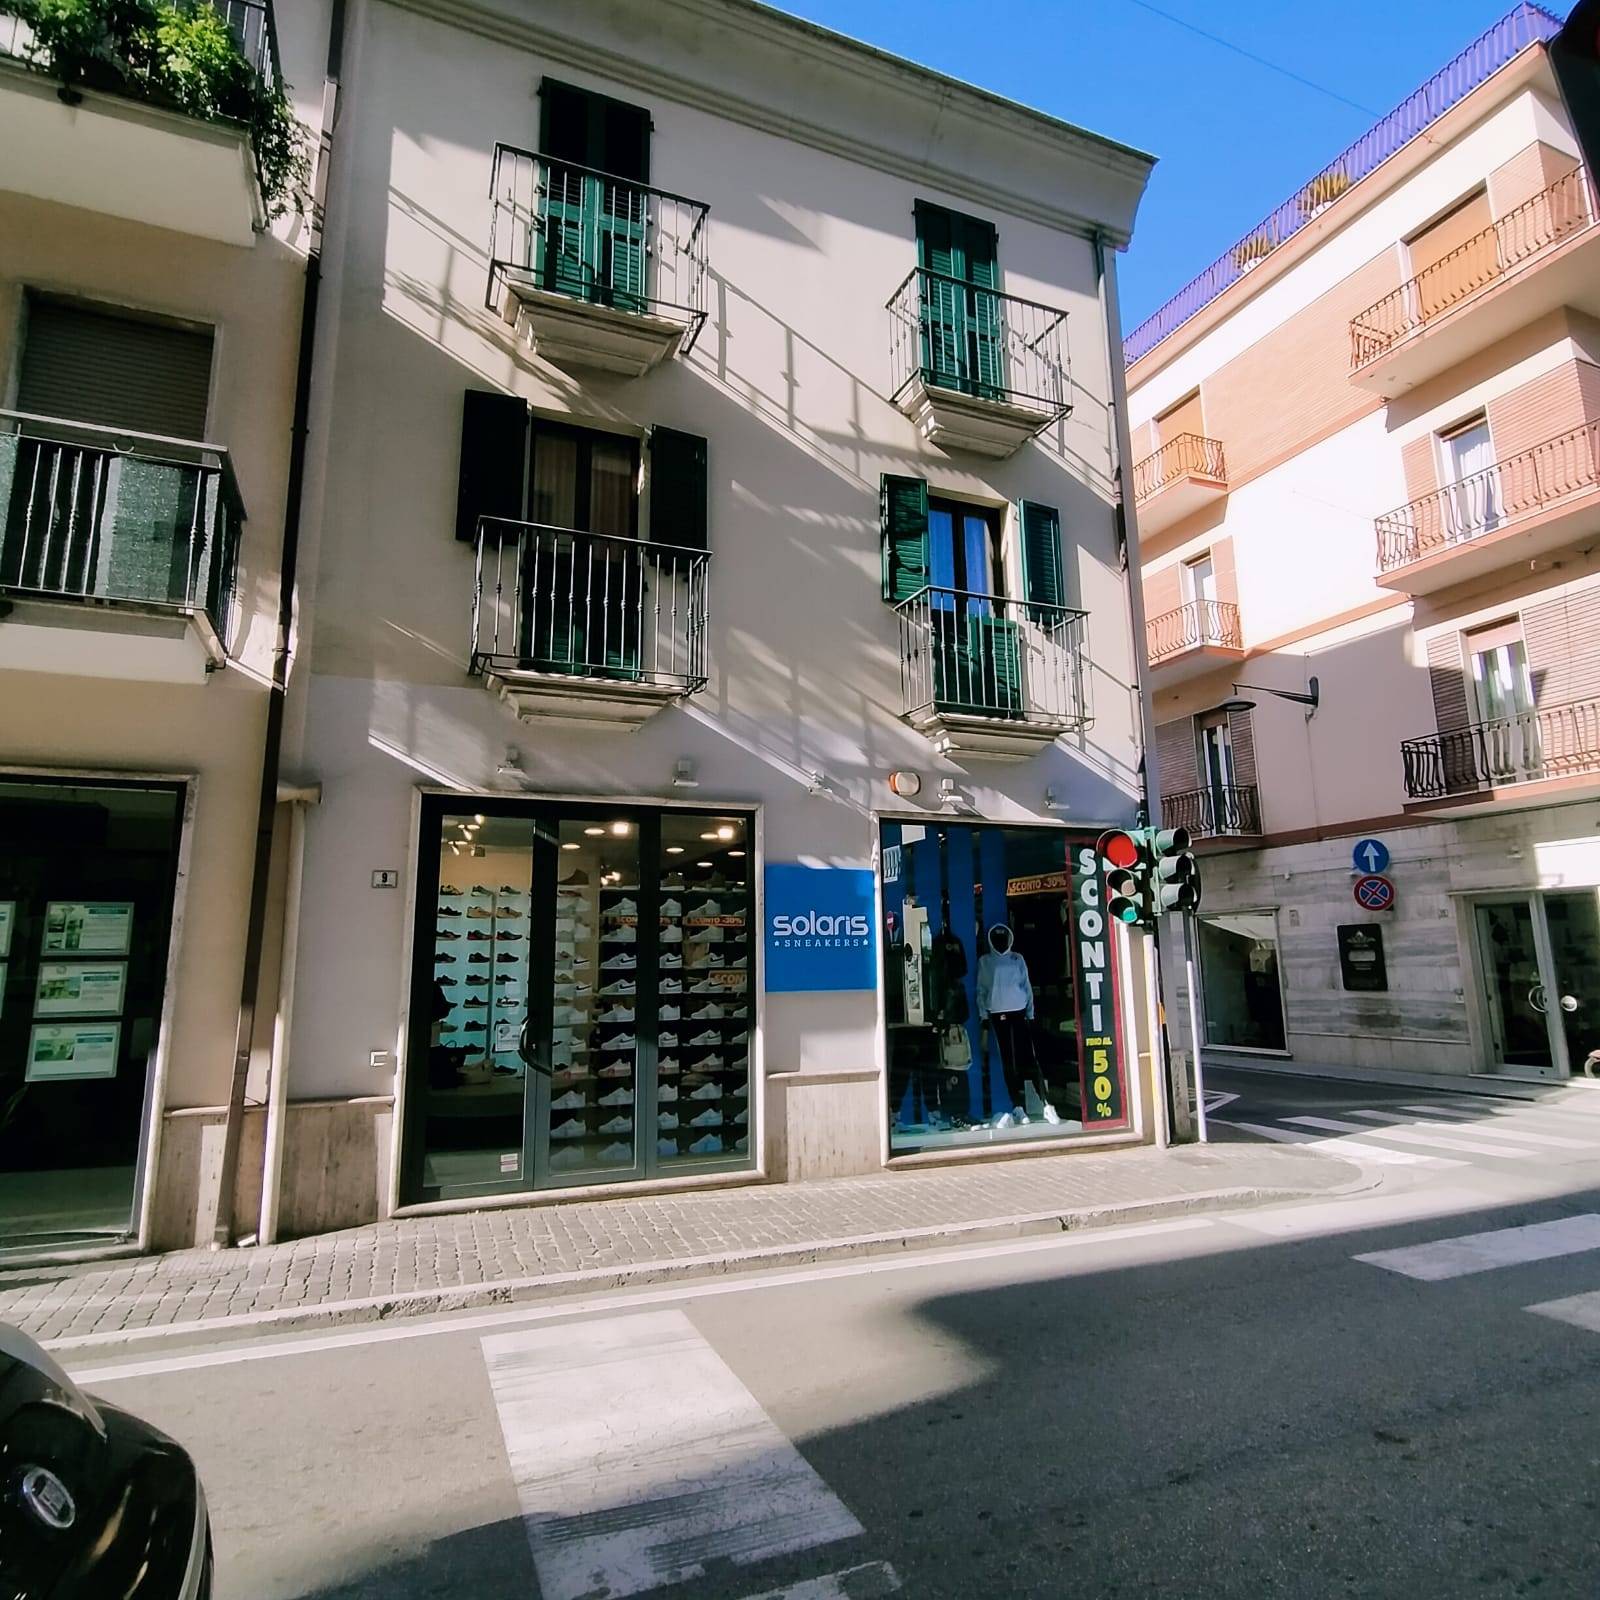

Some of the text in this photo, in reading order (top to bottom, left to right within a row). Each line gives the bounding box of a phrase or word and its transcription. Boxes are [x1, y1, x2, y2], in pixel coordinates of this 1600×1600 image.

[381, 872, 388, 883] 9
[1011, 880, 1042, 892] SCONTO
[773, 910, 869, 936] solaris
[784, 938, 860, 948] SNEAKERS
[1079, 848, 1105, 1032] SCONTI
